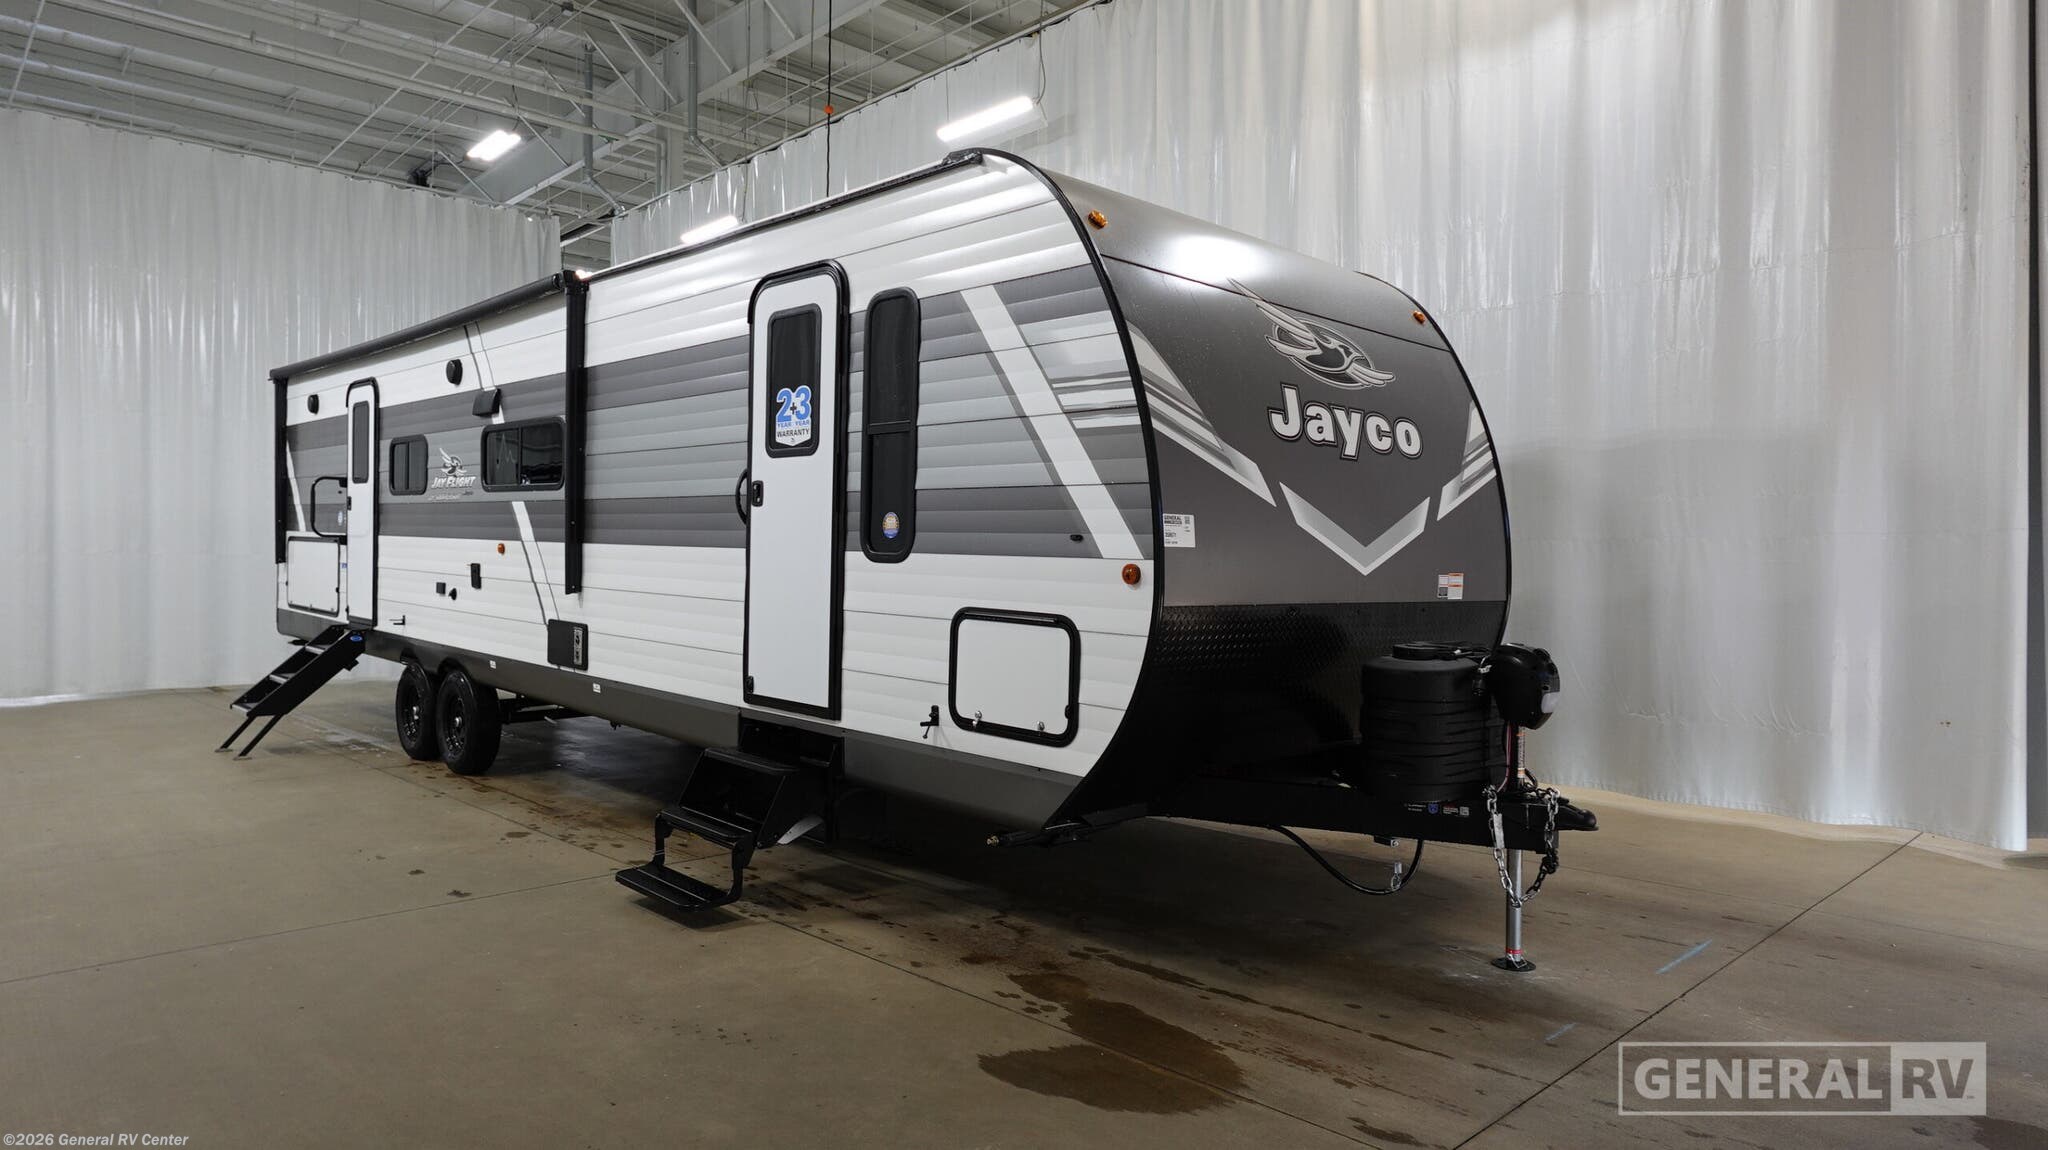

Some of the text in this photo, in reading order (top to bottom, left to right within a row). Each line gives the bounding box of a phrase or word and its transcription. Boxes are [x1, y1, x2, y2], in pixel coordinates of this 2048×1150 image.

[1267, 382, 1423, 461] Jayco
[776, 428, 810, 438] WARRANTY
[431, 475, 477, 489] JAY FLIGHT
